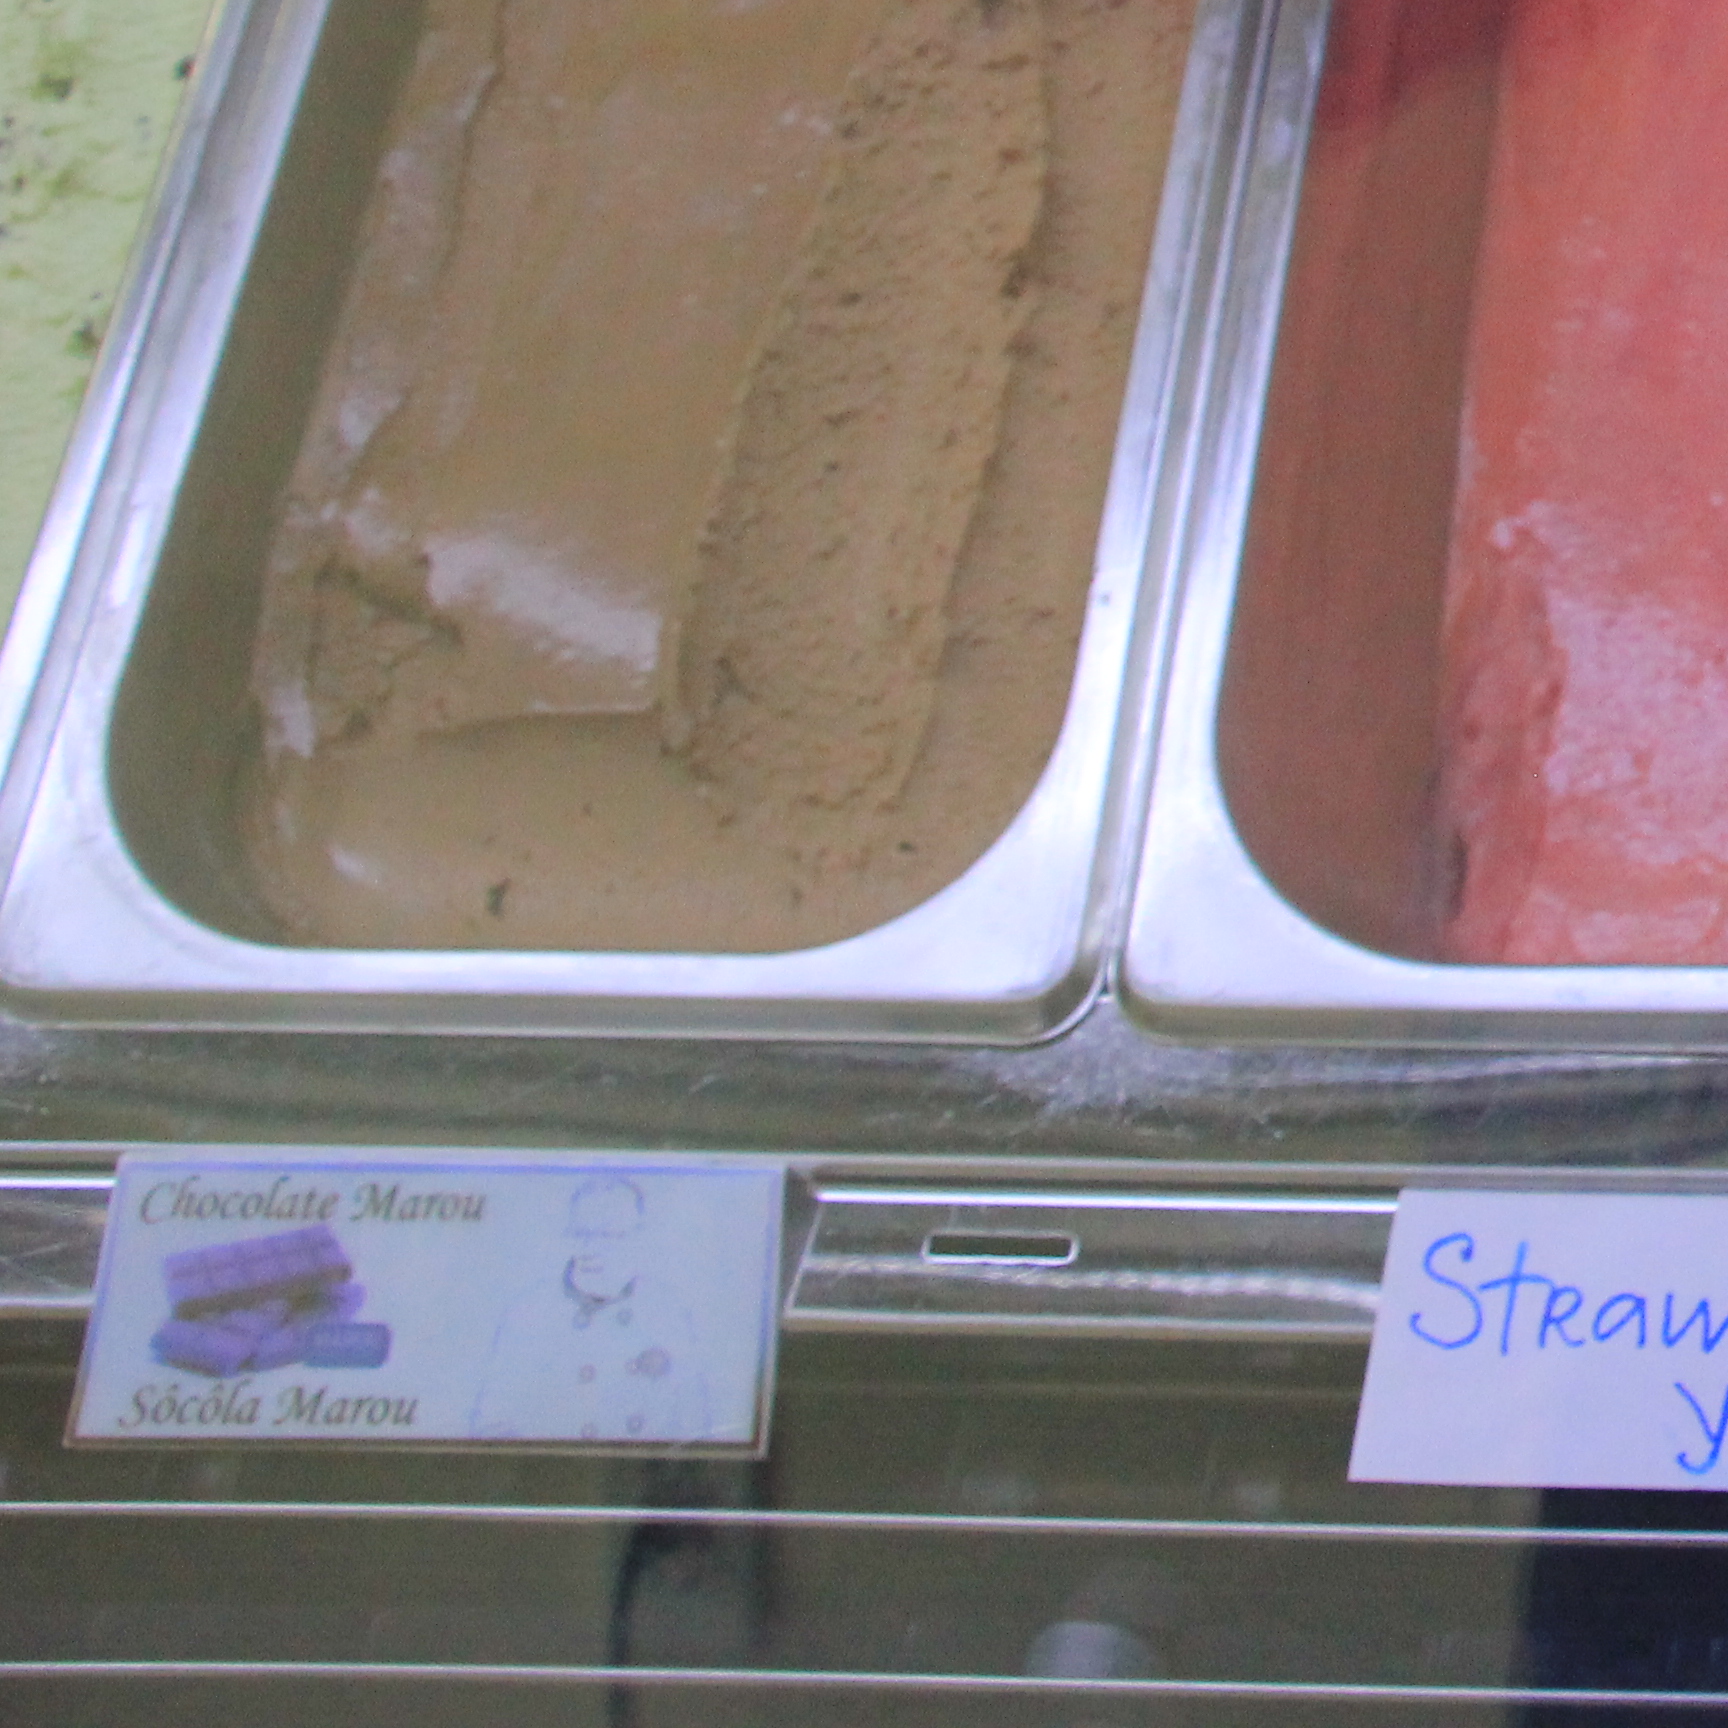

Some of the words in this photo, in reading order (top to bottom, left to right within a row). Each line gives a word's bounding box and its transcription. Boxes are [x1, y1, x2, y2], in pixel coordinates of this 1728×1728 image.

[138, 1174, 340, 1224] Chocolate
[351, 1180, 487, 1222] Marou
[116, 1376, 262, 1428] Sôcôla
[272, 1382, 419, 1428] Marou
